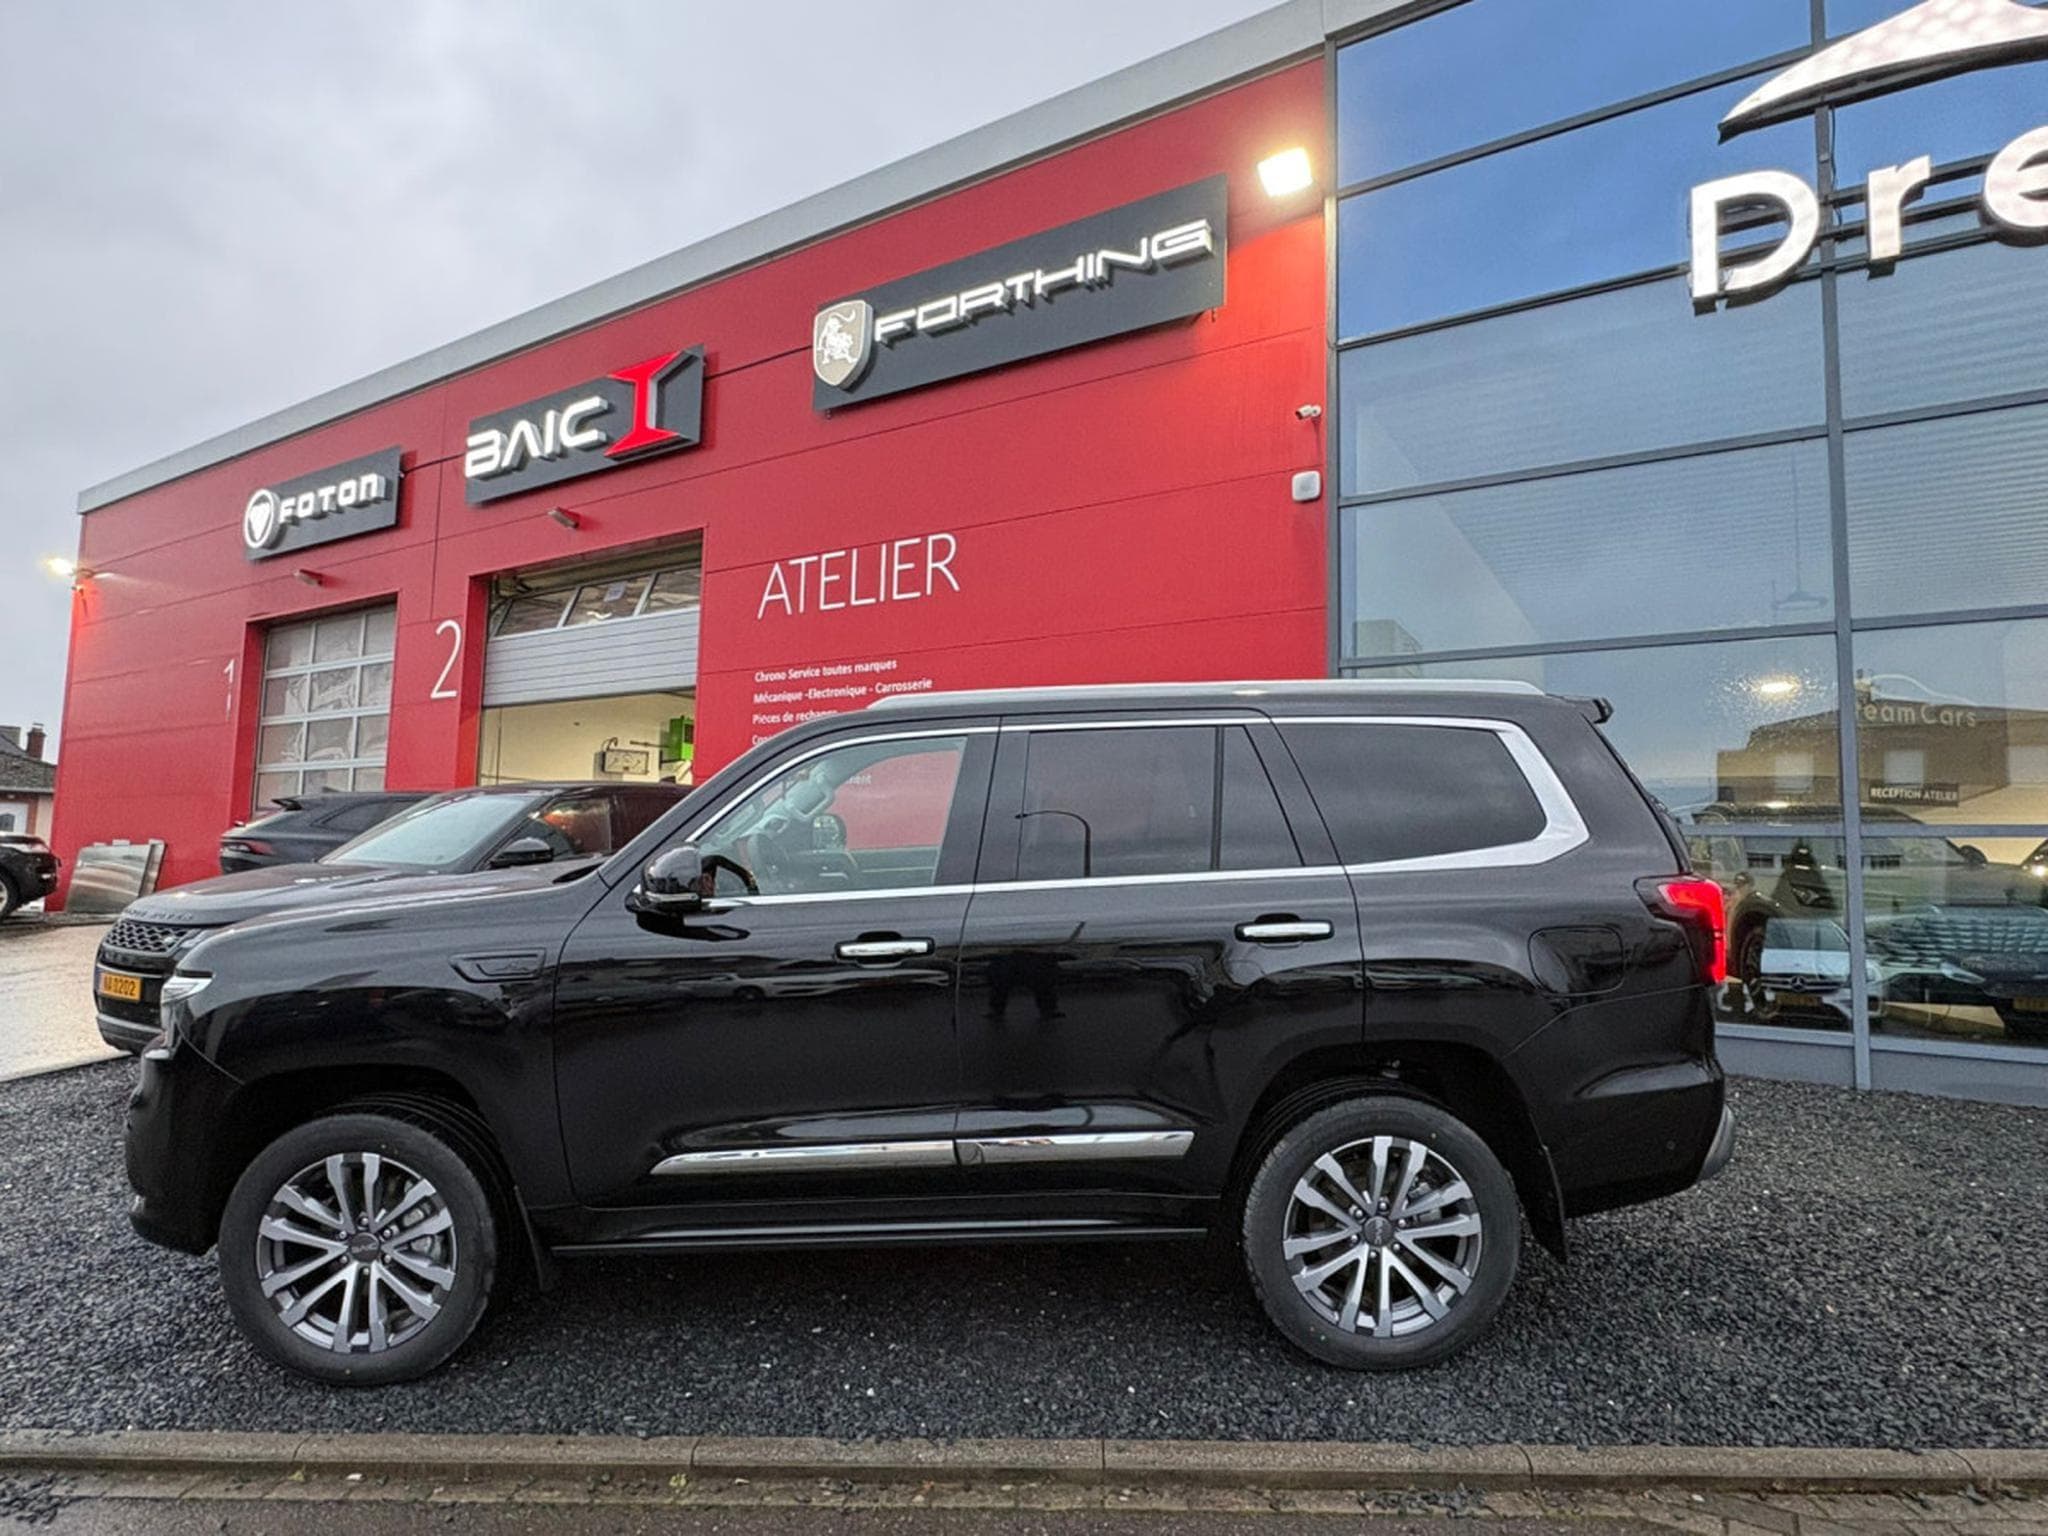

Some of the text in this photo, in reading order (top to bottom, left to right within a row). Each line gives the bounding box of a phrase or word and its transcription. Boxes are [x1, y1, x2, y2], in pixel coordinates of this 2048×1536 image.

[874, 218, 1213, 343] FORTHING
[464, 395, 608, 478] BAIC
[756, 532, 961, 621] ATELIER
[429, 619, 463, 700] 2
[754, 660, 898, 683] Chrono Service toutes marques
[222, 658, 236, 721] 1
[874, 677, 933, 694] Carrosserie
[782, 710, 795, 723] de
[1920, 704, 1977, 727] Cars
[1870, 786, 1958, 801] RECEPTION ATELIER
